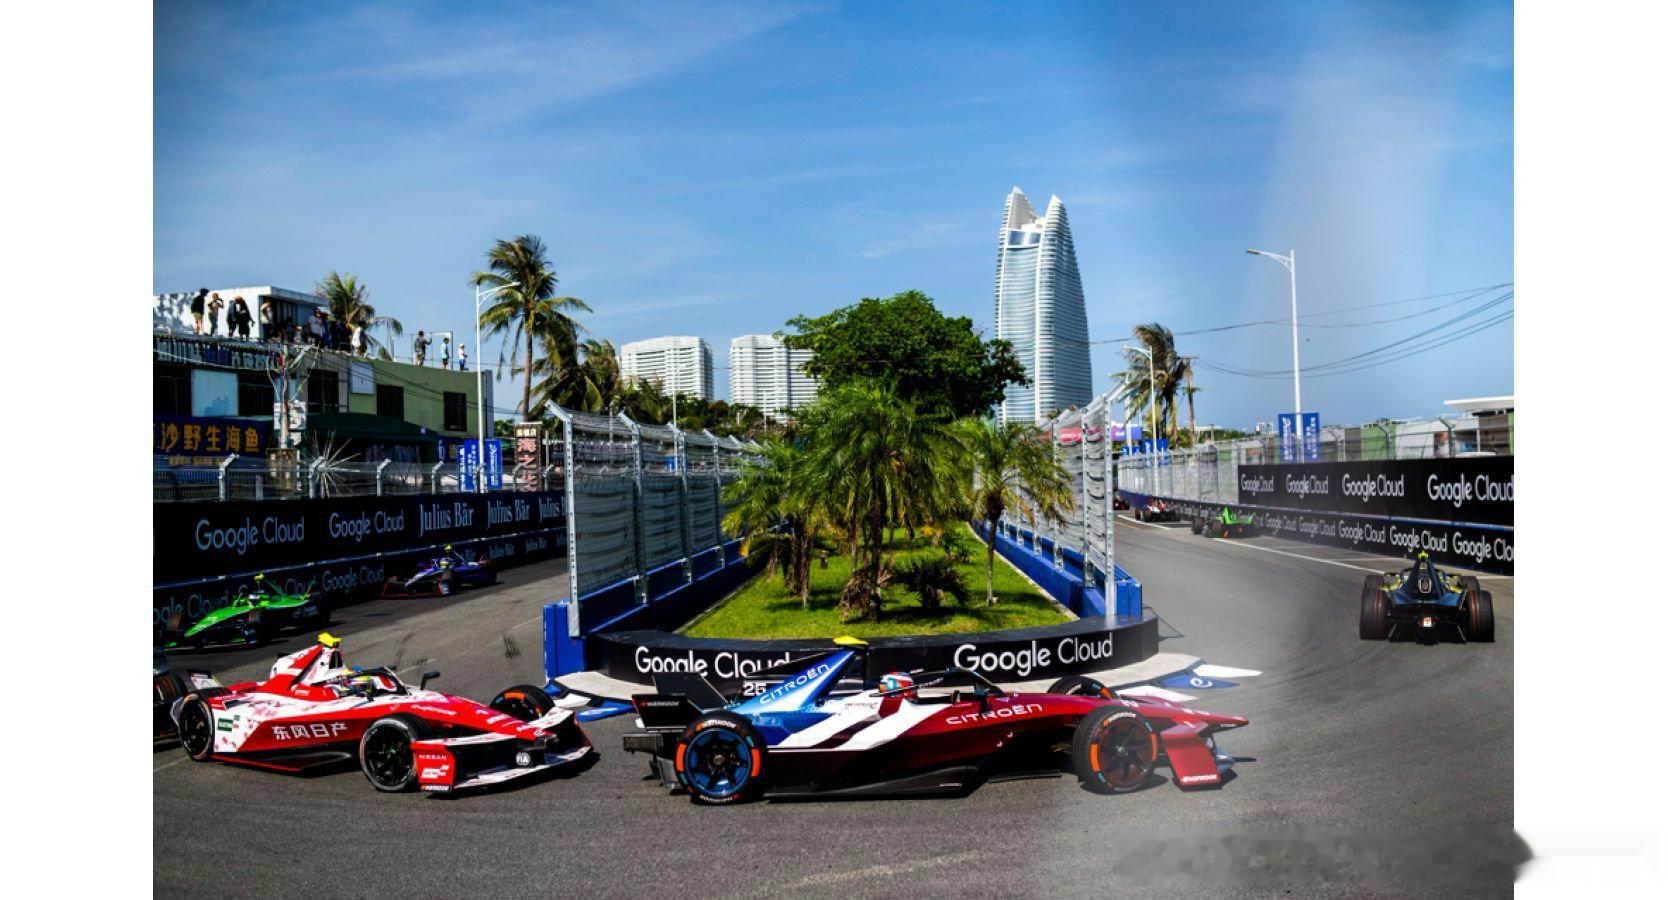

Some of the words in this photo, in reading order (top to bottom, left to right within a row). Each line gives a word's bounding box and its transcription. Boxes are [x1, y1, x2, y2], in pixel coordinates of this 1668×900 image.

[153, 422, 260, 453] 沙野生海鱼
[1241, 473, 1259, 496] Google
[1259, 475, 1274, 492] Cloud
[1285, 473, 1309, 499] Google
[1309, 475, 1329, 494] Cloud
[1342, 473, 1377, 501] Google
[1377, 474, 1405, 497] Cloud
[1427, 473, 1472, 508] Google
[329, 511, 371, 542] Google
[374, 509, 404, 534] Cloud
[419, 503, 451, 537] Julius
[454, 502, 475, 527] Bär
[1338, 520, 1363, 544] Google
[1364, 523, 1386, 543] Cloud
[195, 517, 258, 555] Google
[263, 516, 305, 544] Cloud
[1390, 525, 1420, 553] Google
[1421, 529, 1448, 552] Cloud
[1452, 531, 1491, 563] Google
[321, 570, 358, 593] Google
[359, 566, 385, 584] Cloud
[635, 646, 708, 677] Google
[953, 640, 1051, 677] Google
[1057, 632, 1114, 664] Cloud
[743, 682, 767, 697] 25
[272, 722, 348, 741] 东风日产
